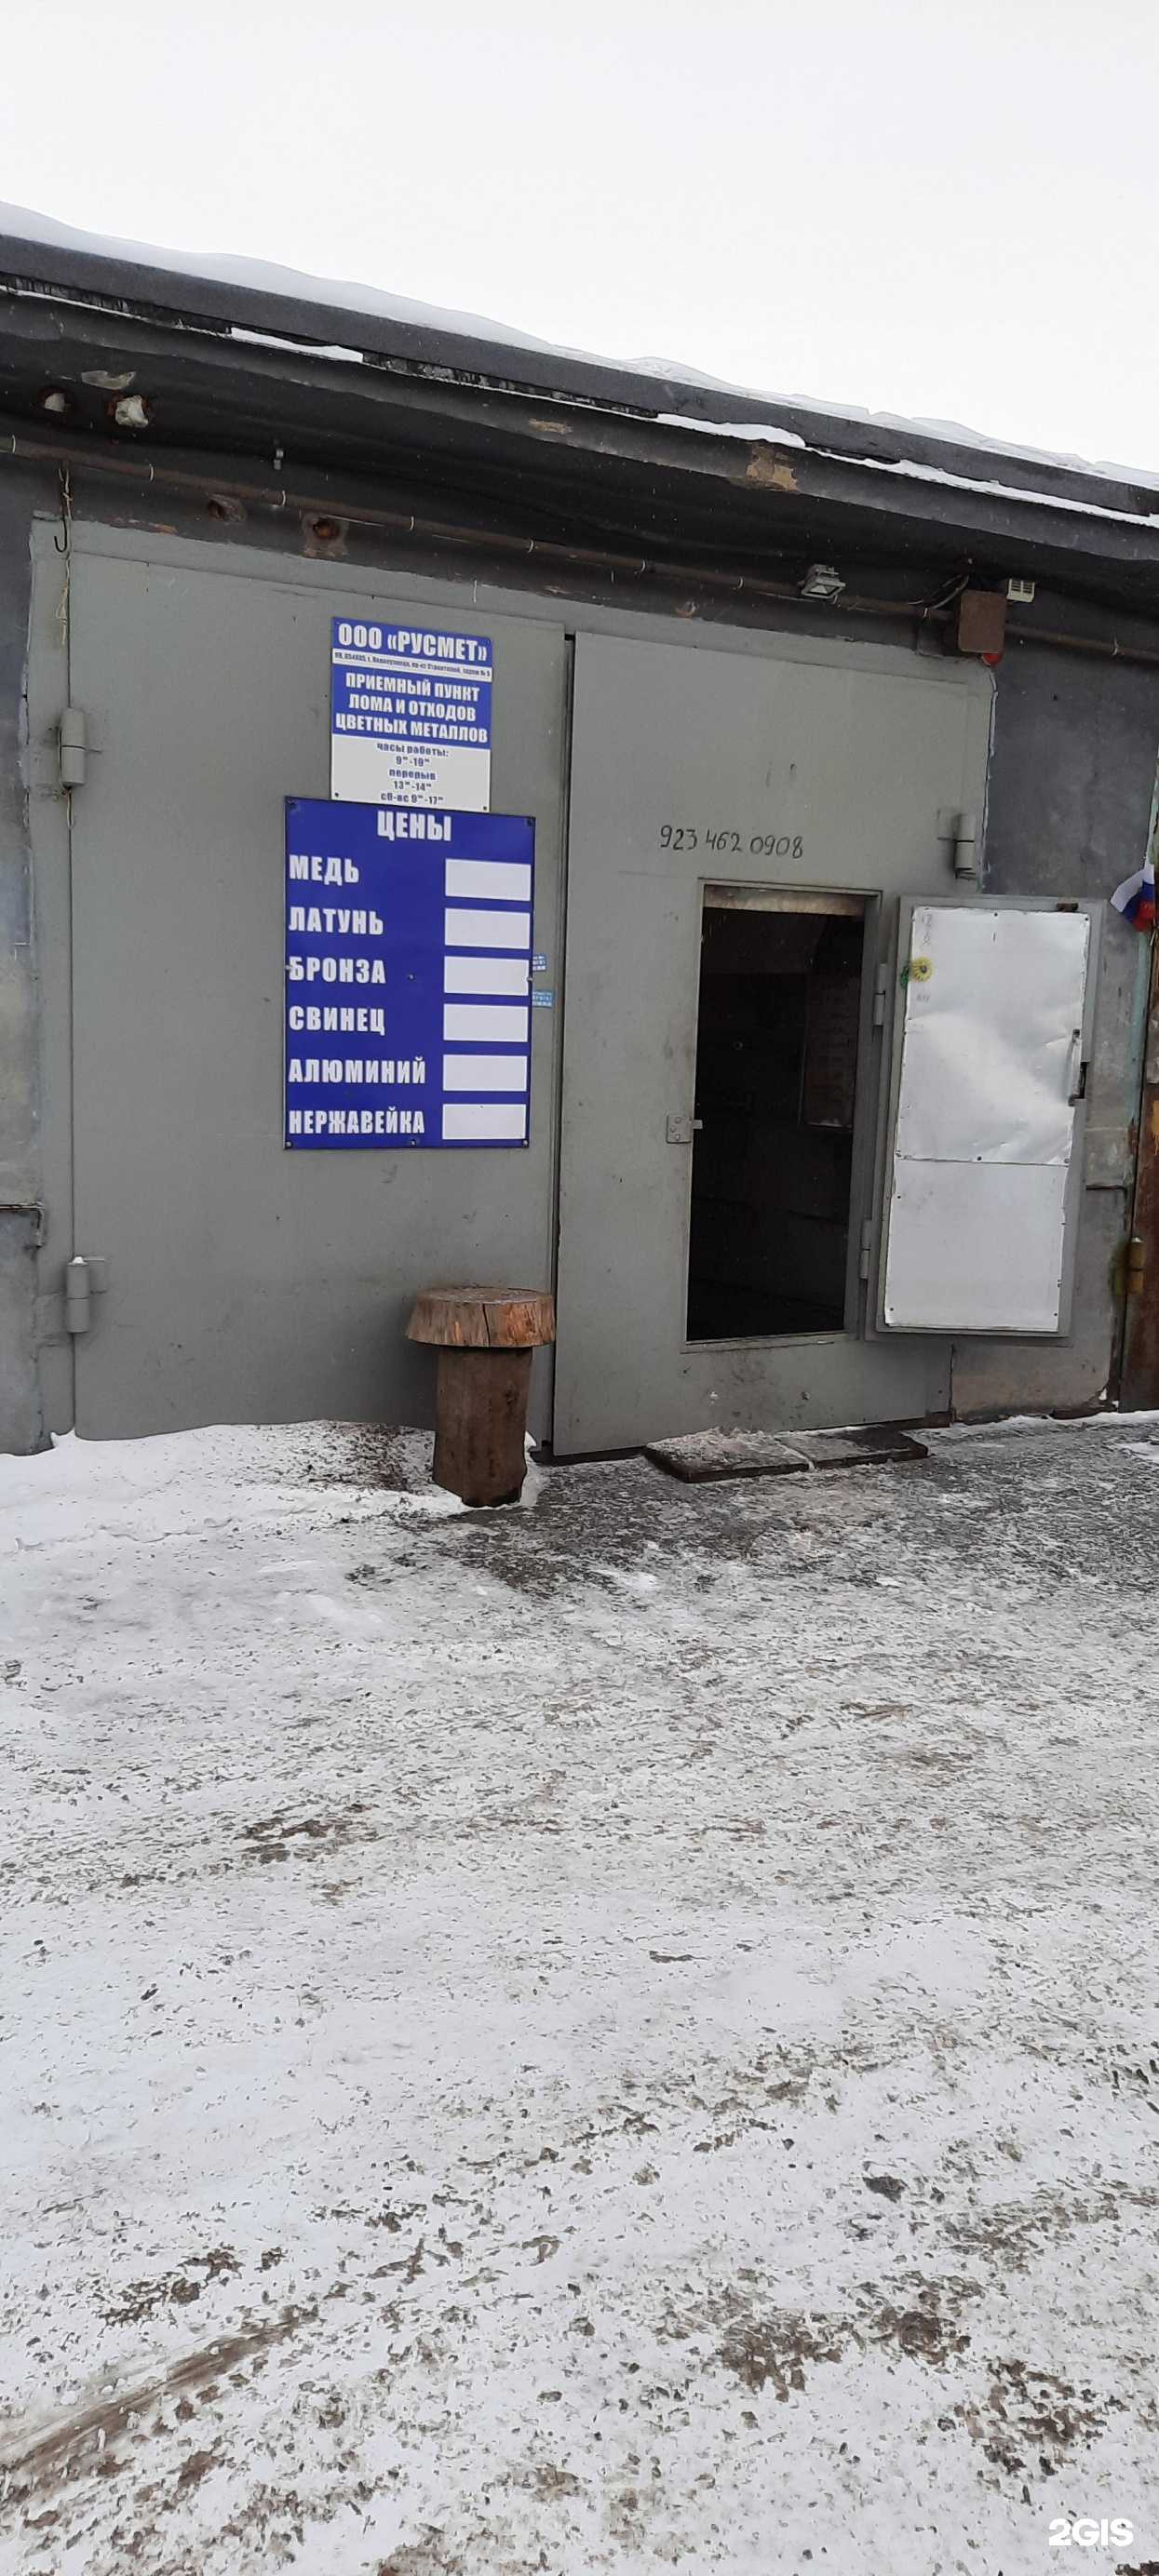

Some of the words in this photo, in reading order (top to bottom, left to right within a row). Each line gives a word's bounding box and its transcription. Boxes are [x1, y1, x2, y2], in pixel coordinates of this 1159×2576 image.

[338, 623, 383, 650] ООО
[387, 631, 488, 662] «РУСМЕТ»
[345, 672, 431, 697] ПРИЕМНЫЙ
[434, 683, 480, 703] ПУНКТ
[348, 693, 393, 714] ЛОМА
[396, 700, 405, 715] И
[409, 702, 476, 722] ОТХОДОВ
[336, 713, 408, 735] ЦВЕТНЫХ
[411, 721, 488, 744] МЕТАЛЛОВ
[377, 743, 405, 753] часы
[407, 745, 450, 758] работы:
[389, 769, 437, 781] перерыв
[377, 811, 451, 842] ЦЕНЫ
[660, 825, 697, 852] 923
[706, 826, 743, 852] 462
[749, 835, 803, 859] 0908
[289, 854, 359, 886] МЕДЬ
[289, 906, 384, 935] ЛАТУНЬ
[289, 957, 386, 985] БРОНЗА
[289, 1006, 385, 1036] СВИНЕЦ
[288, 1055, 426, 1084] АЛЮМИНИЙ
[289, 1106, 425, 1134] НЕРЖАВЕЙКА
